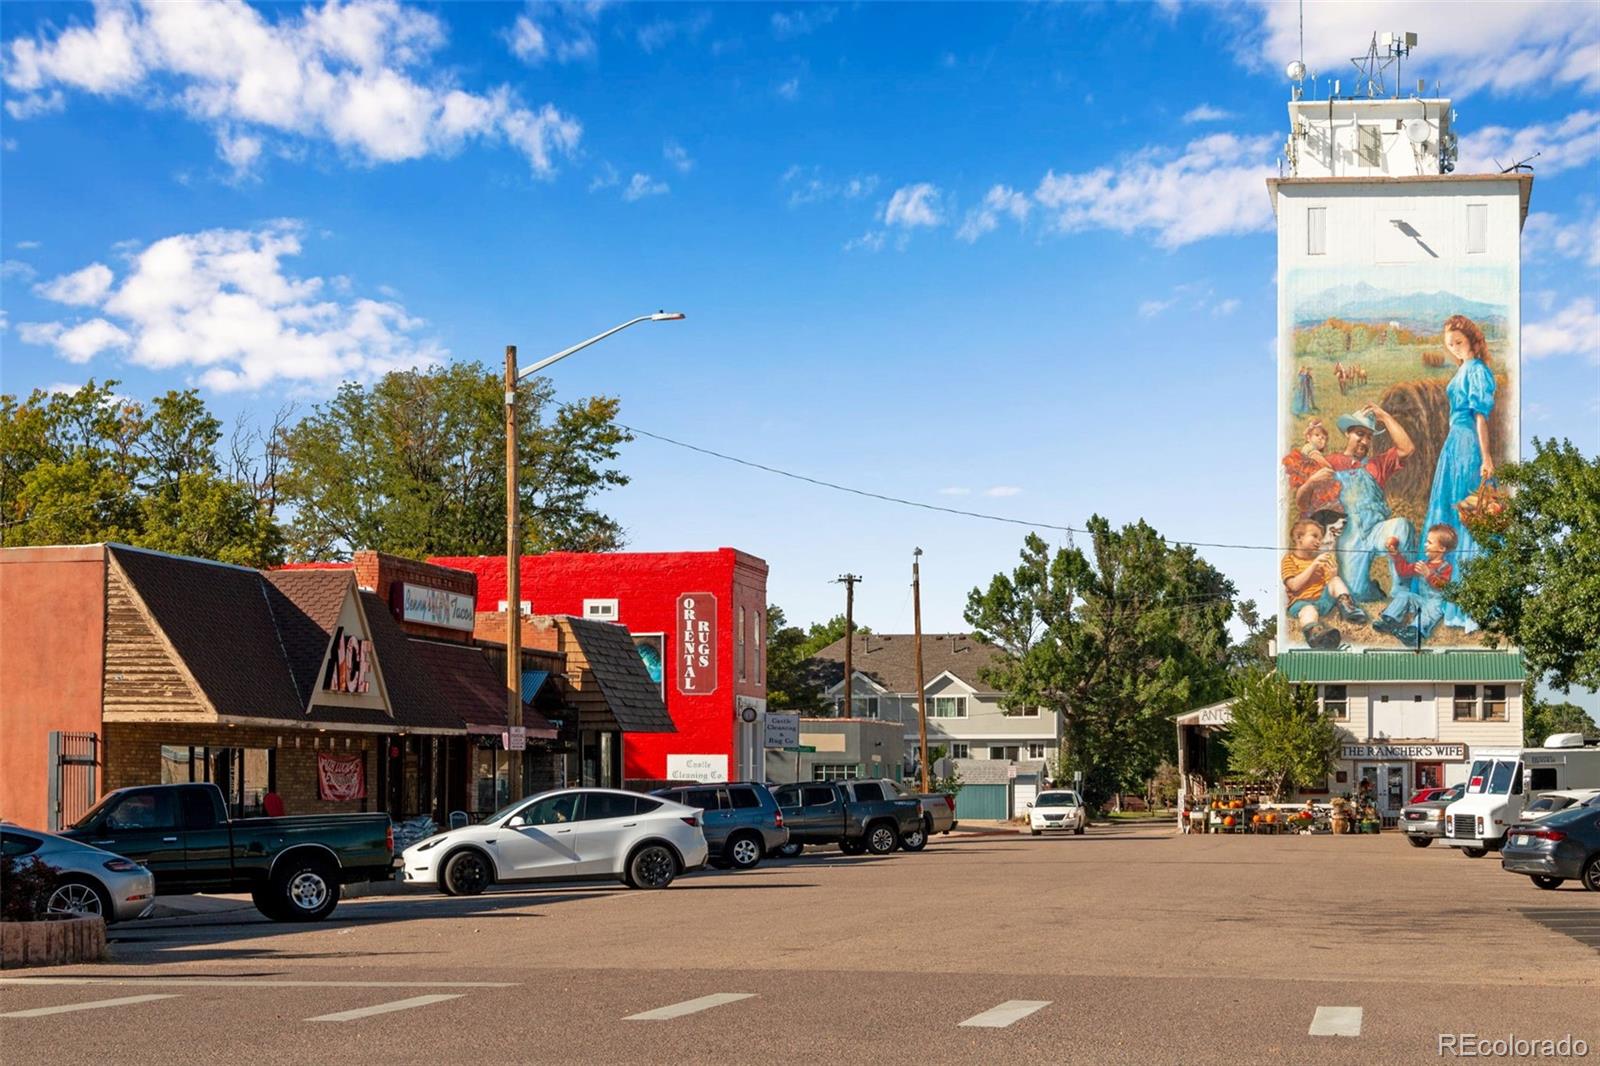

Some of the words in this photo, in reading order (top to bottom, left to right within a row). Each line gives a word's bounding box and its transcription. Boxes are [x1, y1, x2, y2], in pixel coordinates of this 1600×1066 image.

[451, 597, 473, 621] Tacos
[683, 598, 696, 690] ORIENTAL
[697, 621, 710, 667] RUGS
[323, 626, 373, 694] ACE
[1201, 709, 1230, 721] ANTI
[768, 737, 783, 745] Rug
[1342, 746, 1364, 757] THE
[1367, 745, 1432, 757] RANCHER'S
[1435, 746, 1463, 757] WIFE
[686, 760, 711, 768] Castle
[672, 770, 707, 779] Cleaning
